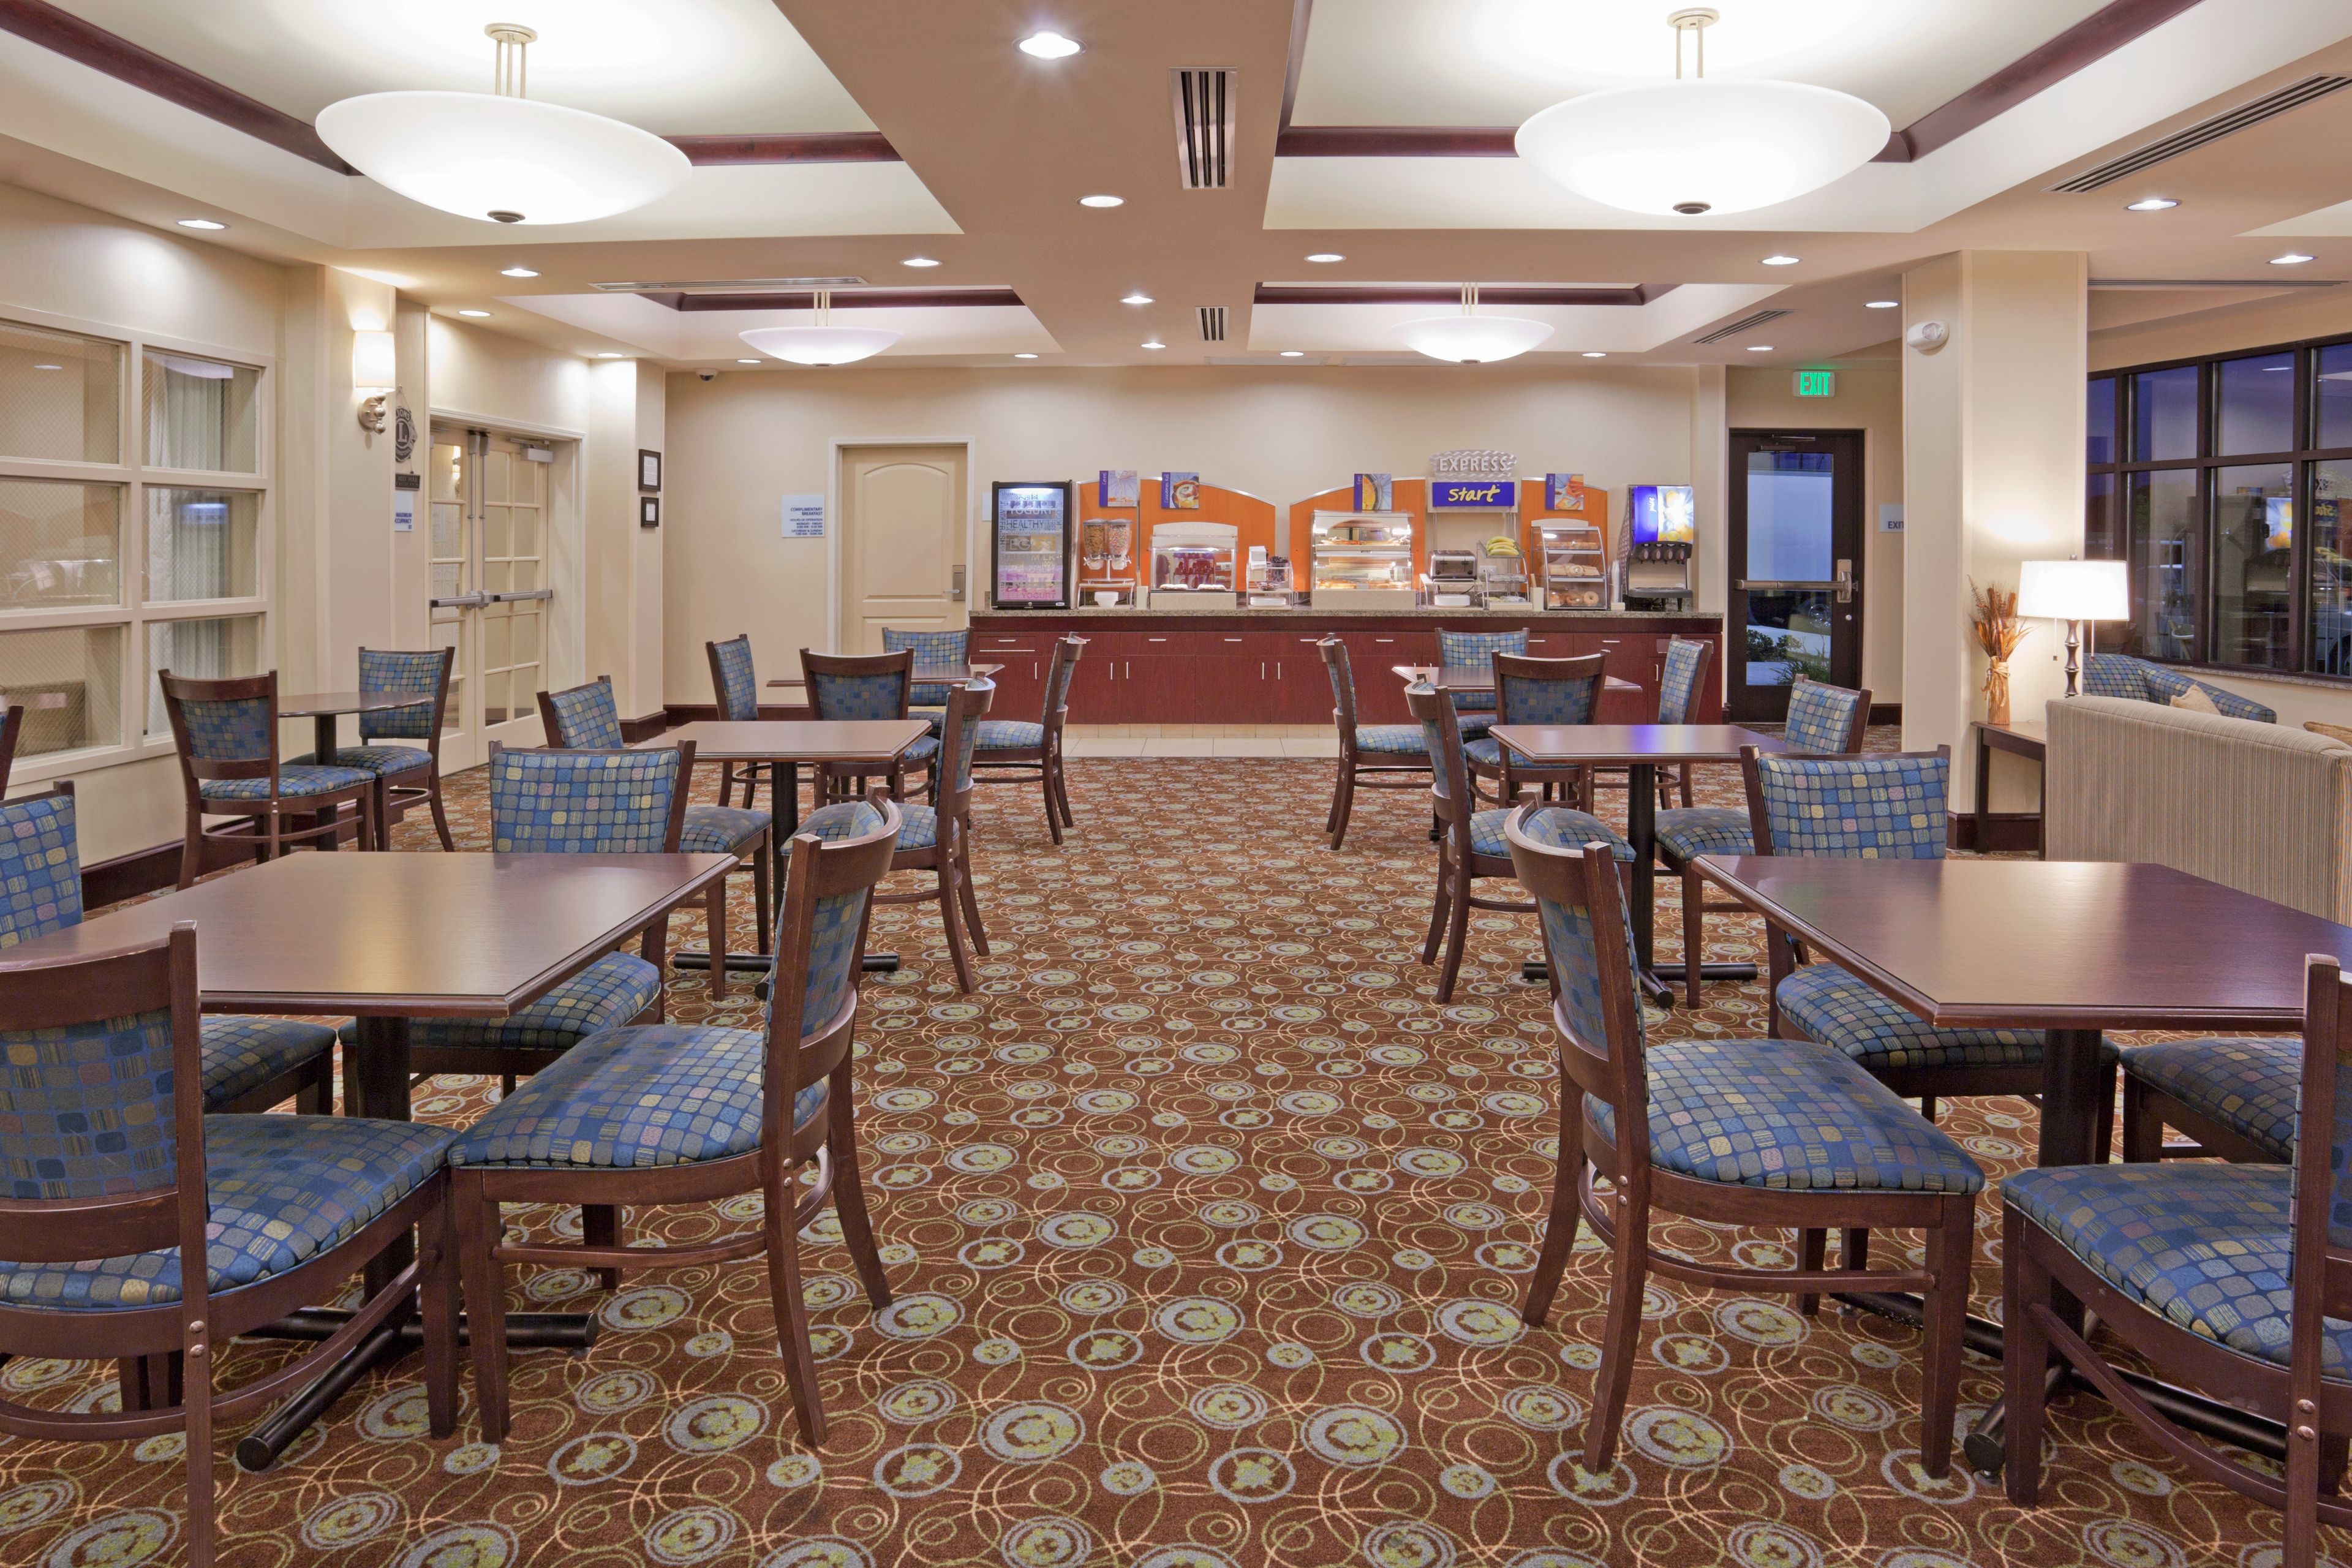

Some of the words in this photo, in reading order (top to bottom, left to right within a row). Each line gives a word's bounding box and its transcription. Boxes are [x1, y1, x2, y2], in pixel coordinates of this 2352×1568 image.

[1800, 372, 1830, 396] EXIT
[398, 422, 407, 442] L
[1439, 458, 1507, 471] EXPRESS
[1009, 505, 1053, 514] YOGURT
[1006, 519, 1044, 529] HEALTHY
